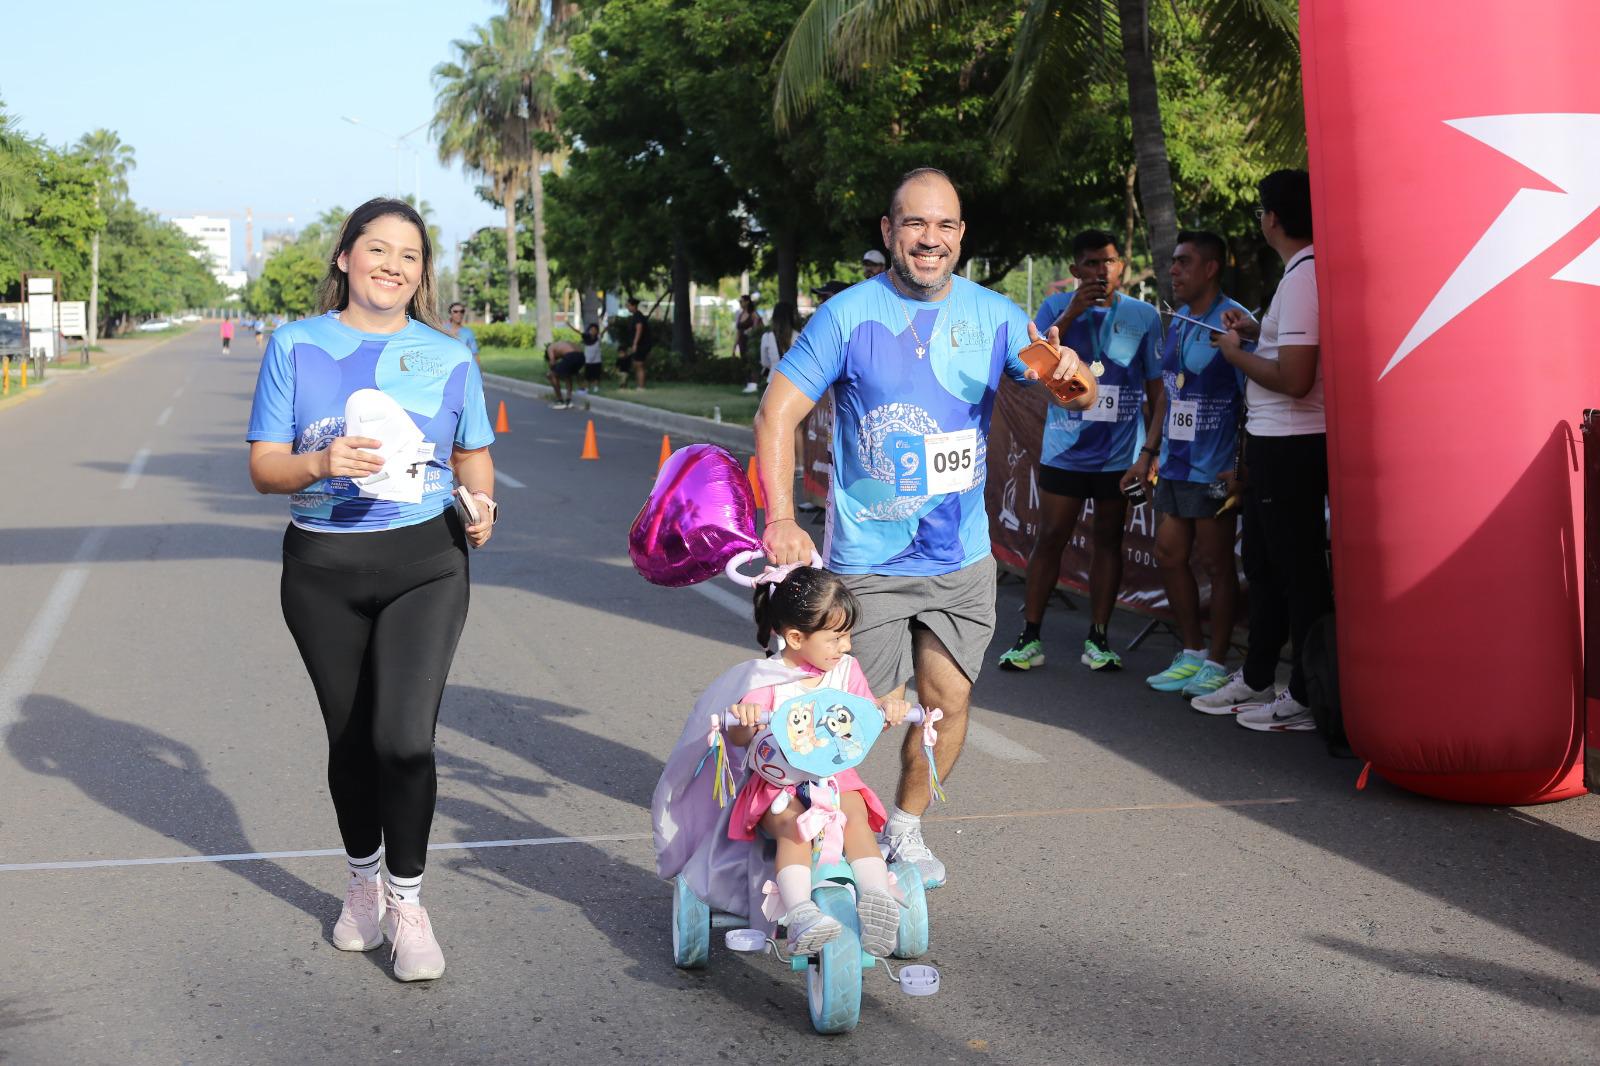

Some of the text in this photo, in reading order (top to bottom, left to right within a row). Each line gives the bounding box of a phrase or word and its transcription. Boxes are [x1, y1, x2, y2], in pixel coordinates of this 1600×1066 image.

[1097, 395, 1114, 409] 79
[1172, 413, 1193, 427] 186
[900, 452, 920, 477] 9
[933, 448, 971, 473] 095
[426, 470, 441, 481] ISIS
[424, 482, 444, 493] RAL
